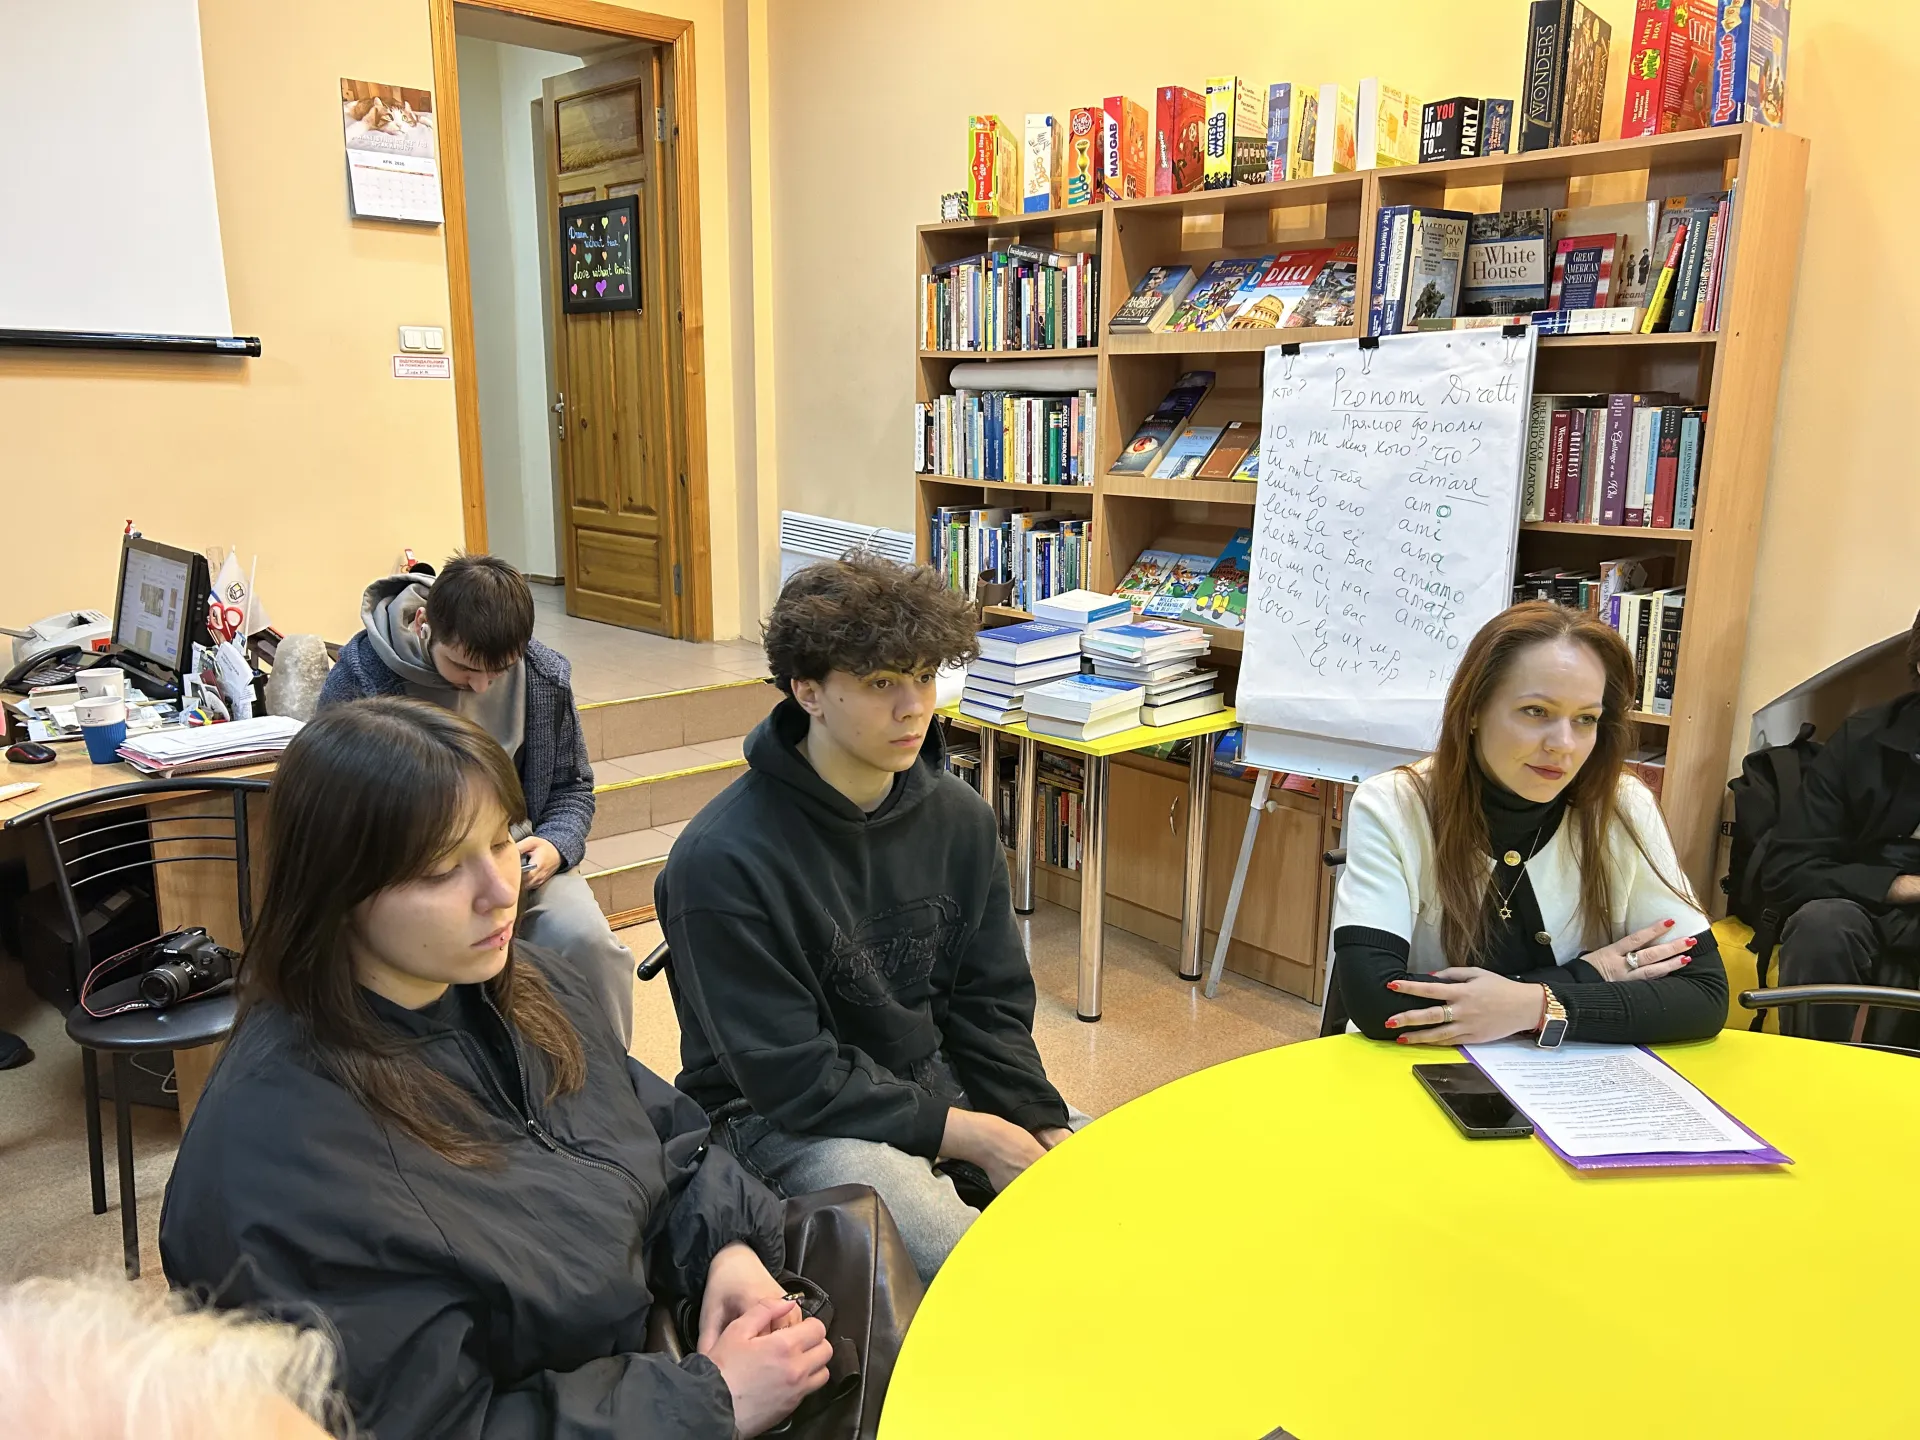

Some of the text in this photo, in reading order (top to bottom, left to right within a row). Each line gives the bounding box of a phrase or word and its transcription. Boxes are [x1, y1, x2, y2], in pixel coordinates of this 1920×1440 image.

[1641, 17, 1654, 45] PARTY
[1652, 21, 1662, 39] BOX
[1531, 25, 1553, 117] WONDERS
[1714, 34, 1735, 122] Rummikub
[1425, 102, 1455, 123] IF YOU
[1208, 127, 1216, 156] WITS
[1215, 113, 1225, 157] WAGERS
[1423, 121, 1442, 139] HAD
[1460, 105, 1478, 156] PARTY
[1109, 123, 1118, 176] MAD GAB
[1423, 139, 1446, 154] TO...
[978, 163, 987, 181] Eggs
[1273, 157, 1283, 181] USA
[569, 226, 588, 239] Dream
[1395, 217, 1406, 260] AMERICAN
[1691, 220, 1701, 246] ALMANAC
[1706, 222, 1717, 251] OUTLINE
[1376, 210, 1391, 290] The American Journey
[1484, 245, 1536, 265] White
[1573, 251, 1594, 263] GREAT
[1705, 251, 1712, 261] OF
[574, 261, 590, 280] Love
[592, 264, 612, 277] without
[1265, 265, 1313, 282] DIECI
[1472, 262, 1527, 280] House
[1564, 273, 1598, 285] SPEECHES
[1565, 262, 1599, 274] AMERICAN
[1127, 296, 1162, 304] ALBERTO
[1698, 274, 1709, 302] HISTORY
[1116, 308, 1155, 317] CESARE
[1333, 367, 1519, 407] Pronomi Diretti
[1267, 445, 1284, 469] tu
[1526, 401, 1541, 507] WORLD CIVILIZATIONS
[1537, 451, 1543, 462] OF
[1553, 426, 1567, 490] Western Civilization
[1567, 432, 1581, 478] GREATNESS
[1610, 430, 1624, 464] Challenge
[1304, 455, 1323, 482] ti
[1684, 452, 1692, 485] UNFINISHED
[1306, 485, 1327, 507] lo
[1409, 471, 1490, 498] amare
[1606, 479, 1618, 500] West
[1336, 500, 1364, 516] его
[1305, 508, 1331, 536] la
[1398, 518, 1443, 541] ami
[1393, 567, 1464, 604] amiamo
[1258, 586, 1293, 623] loro
[1395, 587, 1455, 629] amate
[1395, 608, 1458, 650] amano
[1666, 633, 1671, 641] A
[1661, 642, 1675, 650] WAR
[1663, 650, 1672, 658] TO
[1658, 666, 1674, 675] WON
